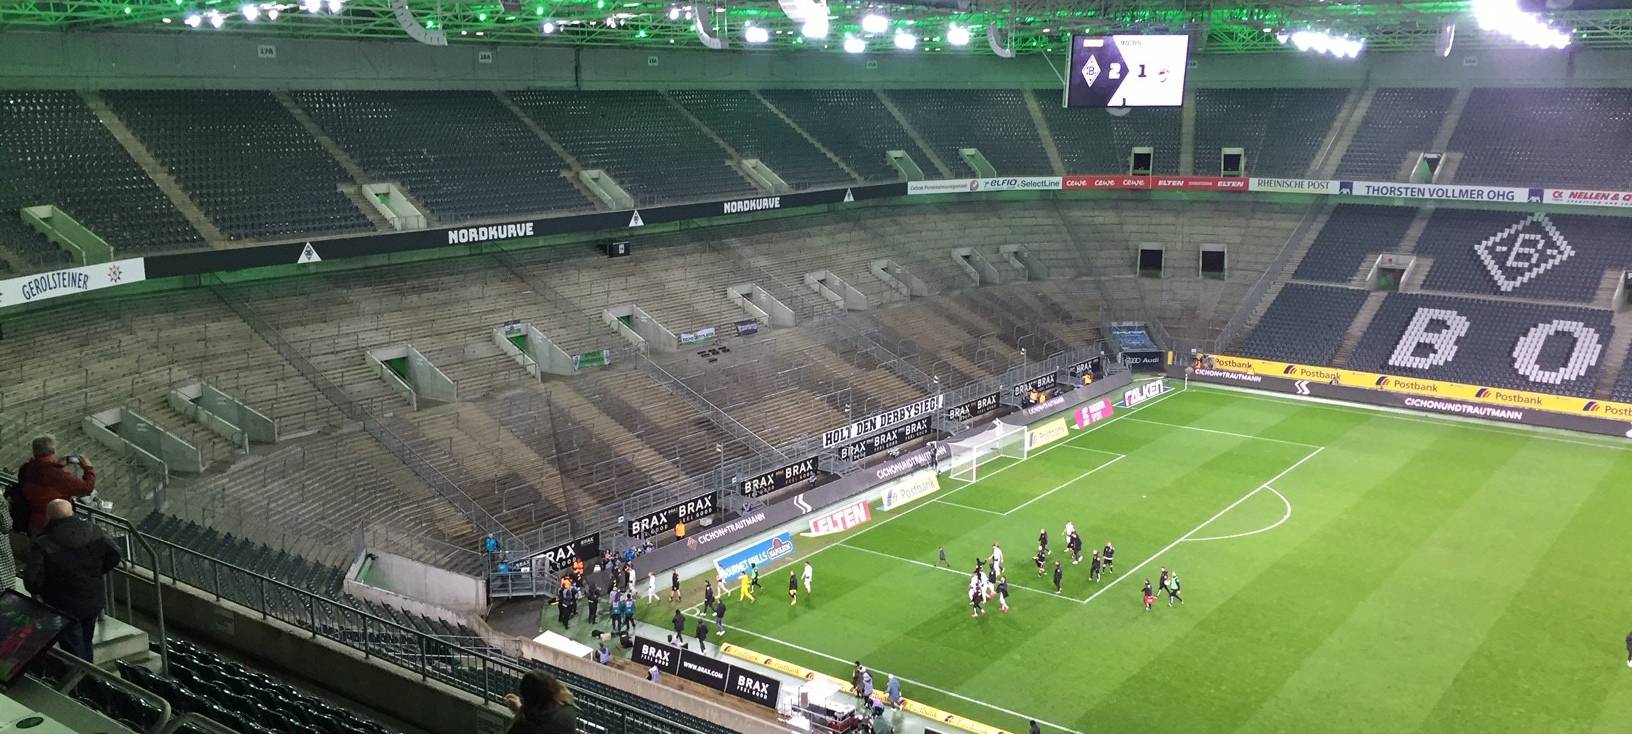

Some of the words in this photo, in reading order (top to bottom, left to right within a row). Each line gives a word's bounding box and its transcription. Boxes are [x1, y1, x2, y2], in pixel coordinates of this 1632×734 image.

[1108, 62, 1121, 79] 2
[1138, 64, 1146, 77] 1
[1021, 180, 1060, 189] SelectLine
[1217, 180, 1244, 188] ELTEN
[1257, 179, 1306, 189] RHEINISCHE
[1307, 180, 1330, 190] POST
[1365, 185, 1425, 197] THORSTEN
[1428, 187, 1484, 200] VOLLMER
[1487, 189, 1515, 201] OHG
[1568, 191, 1610, 200] NELLEN
[723, 196, 781, 214] NORDKURVE
[447, 222, 535, 245] NORDKURVE
[21, 272, 89, 301] GEROLSTEINER
[1076, 361, 1092, 373] BRAX
[1216, 358, 1253, 371] Postbank
[1037, 374, 1055, 388] BRAX
[1300, 368, 1342, 381] Postbank
[1125, 379, 1164, 407] FALKEN
[1394, 379, 1438, 393] Postbank
[977, 395, 996, 409] BRAX
[1495, 391, 1542, 405] Postbank
[949, 405, 970, 420] BRAX
[1404, 397, 1522, 421] CICHONUNDTRAUTMANN
[825, 424, 852, 446] HOLT
[857, 417, 877, 436] DEN
[905, 419, 928, 436] BRAX
[874, 429, 898, 446] BRAX
[841, 440, 866, 459] BRAX
[785, 459, 813, 479] BRAX
[745, 473, 774, 494] BRAX
[678, 495, 712, 518] BRAX
[632, 510, 668, 535] BRAX
[817, 501, 867, 533] ELTEN
[532, 544, 576, 563] RAX
[642, 644, 670, 662] BRAX
[683, 661, 723, 680] WWW.BRAX.COM
[736, 685, 750, 694] FEEL
[737, 675, 769, 694] BRAX
